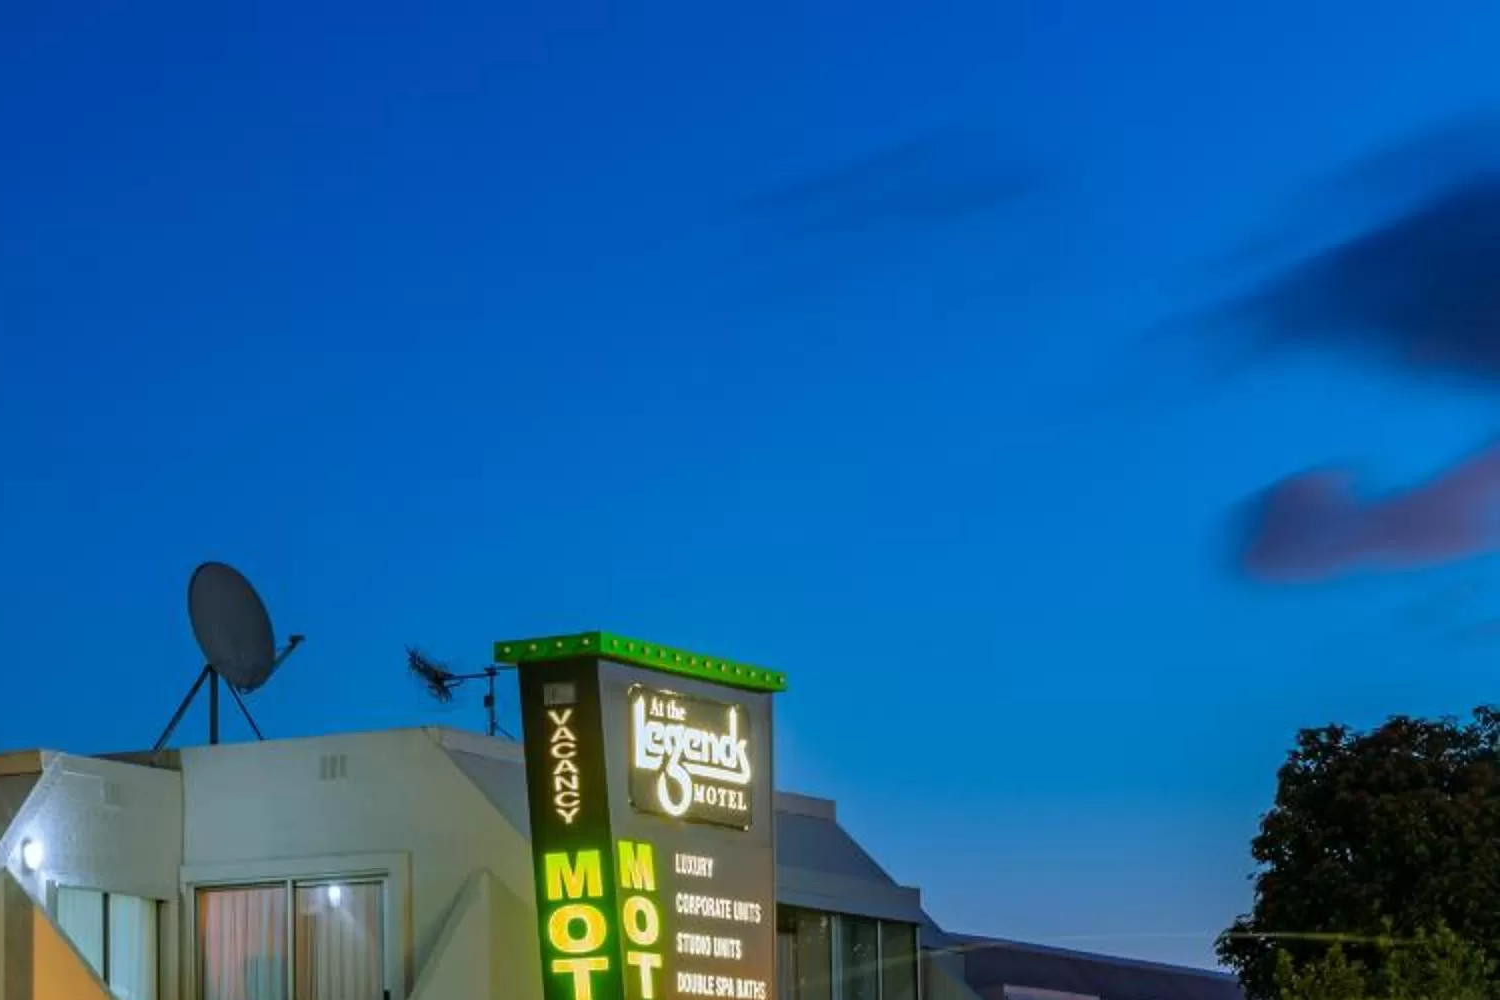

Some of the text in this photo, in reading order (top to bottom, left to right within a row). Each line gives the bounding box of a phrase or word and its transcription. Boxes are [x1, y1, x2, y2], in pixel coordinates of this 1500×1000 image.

[650, 698, 687, 721] At the
[547, 708, 581, 825] VACANCY
[634, 695, 752, 817] Legends
[692, 783, 748, 812] MOTEL
[675, 853, 714, 878] LUXURY
[675, 892, 762, 924] CORPORATE UNITS
[676, 931, 742, 960] STUDIO UNITS
[677, 971, 715, 996] DOUBLE
[715, 975, 734, 998] SPA
